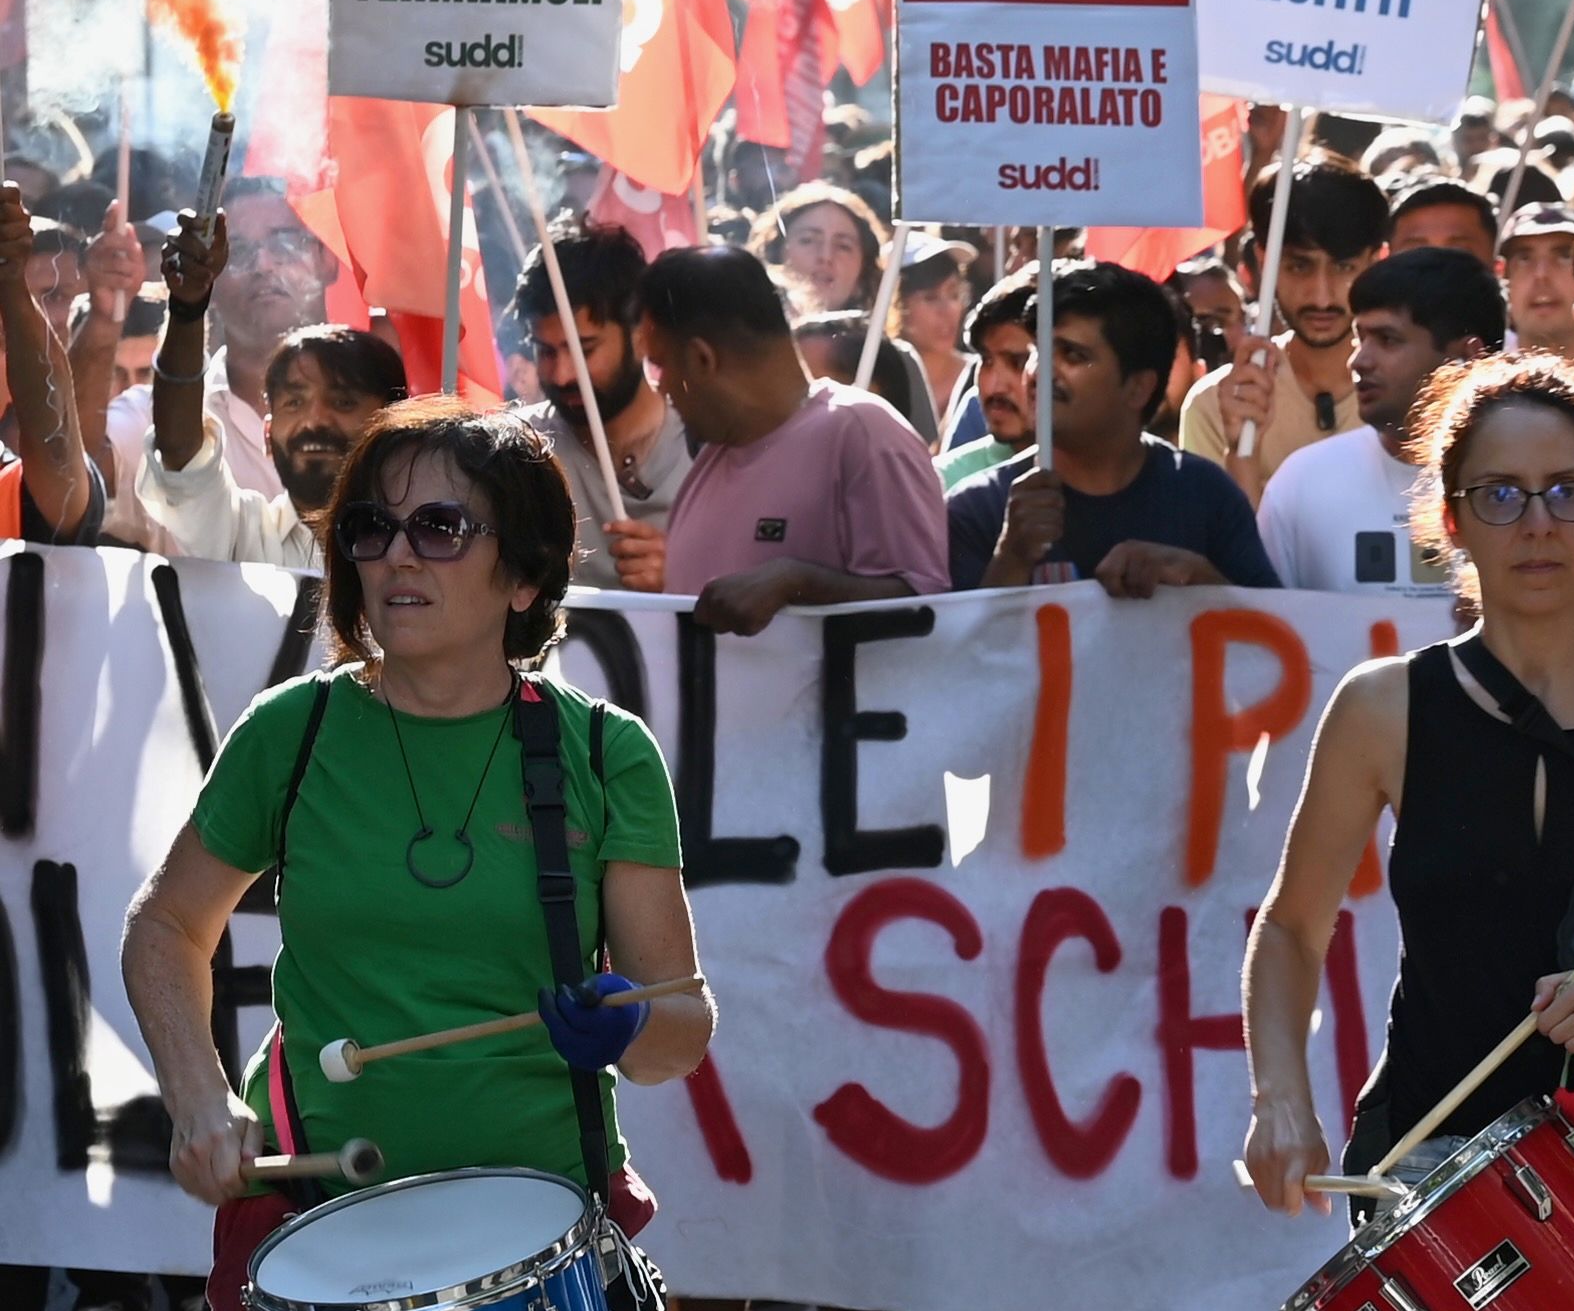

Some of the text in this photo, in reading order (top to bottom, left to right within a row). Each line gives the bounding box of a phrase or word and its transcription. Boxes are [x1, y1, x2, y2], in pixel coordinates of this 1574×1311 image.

[929, 41, 1168, 84] BASTA MAFIA E
[935, 83, 1162, 128] CAPORALATO
